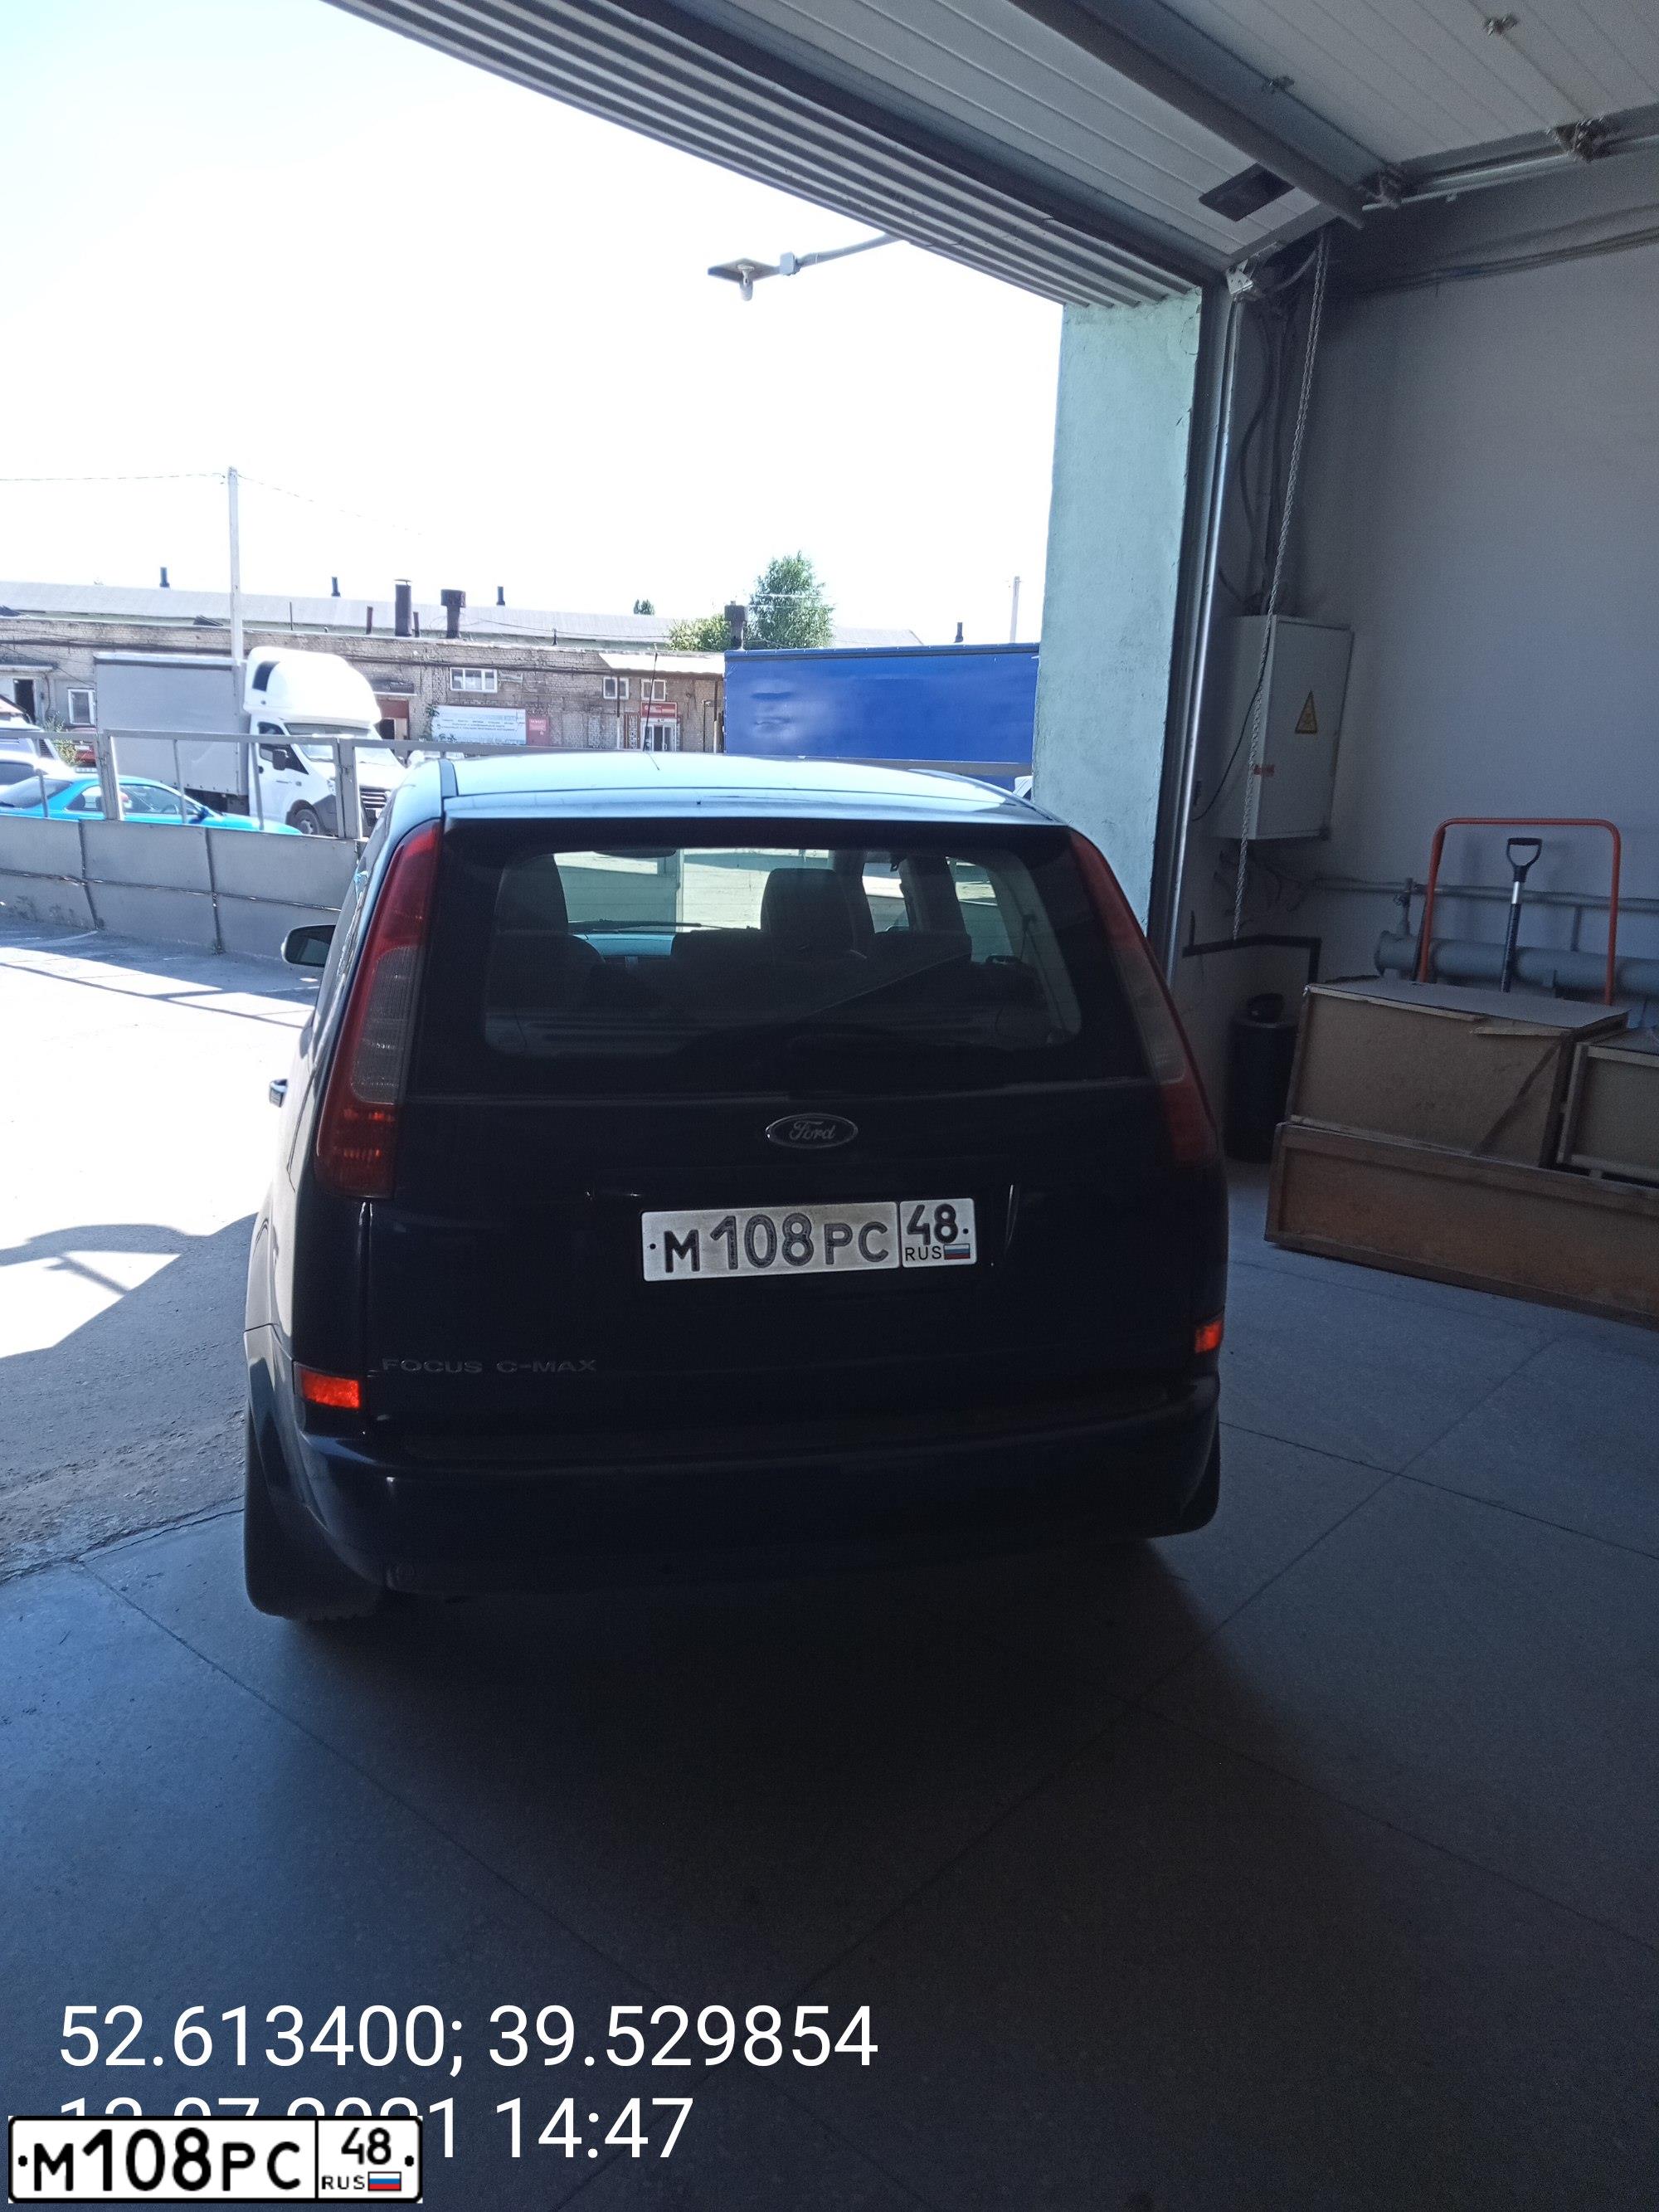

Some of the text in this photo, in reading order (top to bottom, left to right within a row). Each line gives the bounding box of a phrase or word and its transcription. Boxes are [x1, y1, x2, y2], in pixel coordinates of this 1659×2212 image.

[789, 1120, 836, 1140] Ford
[906, 1203, 959, 1245] 48
[904, 1245, 942, 1262] RUS
[382, 1358, 596, 1373] FOCUS C-MAX
